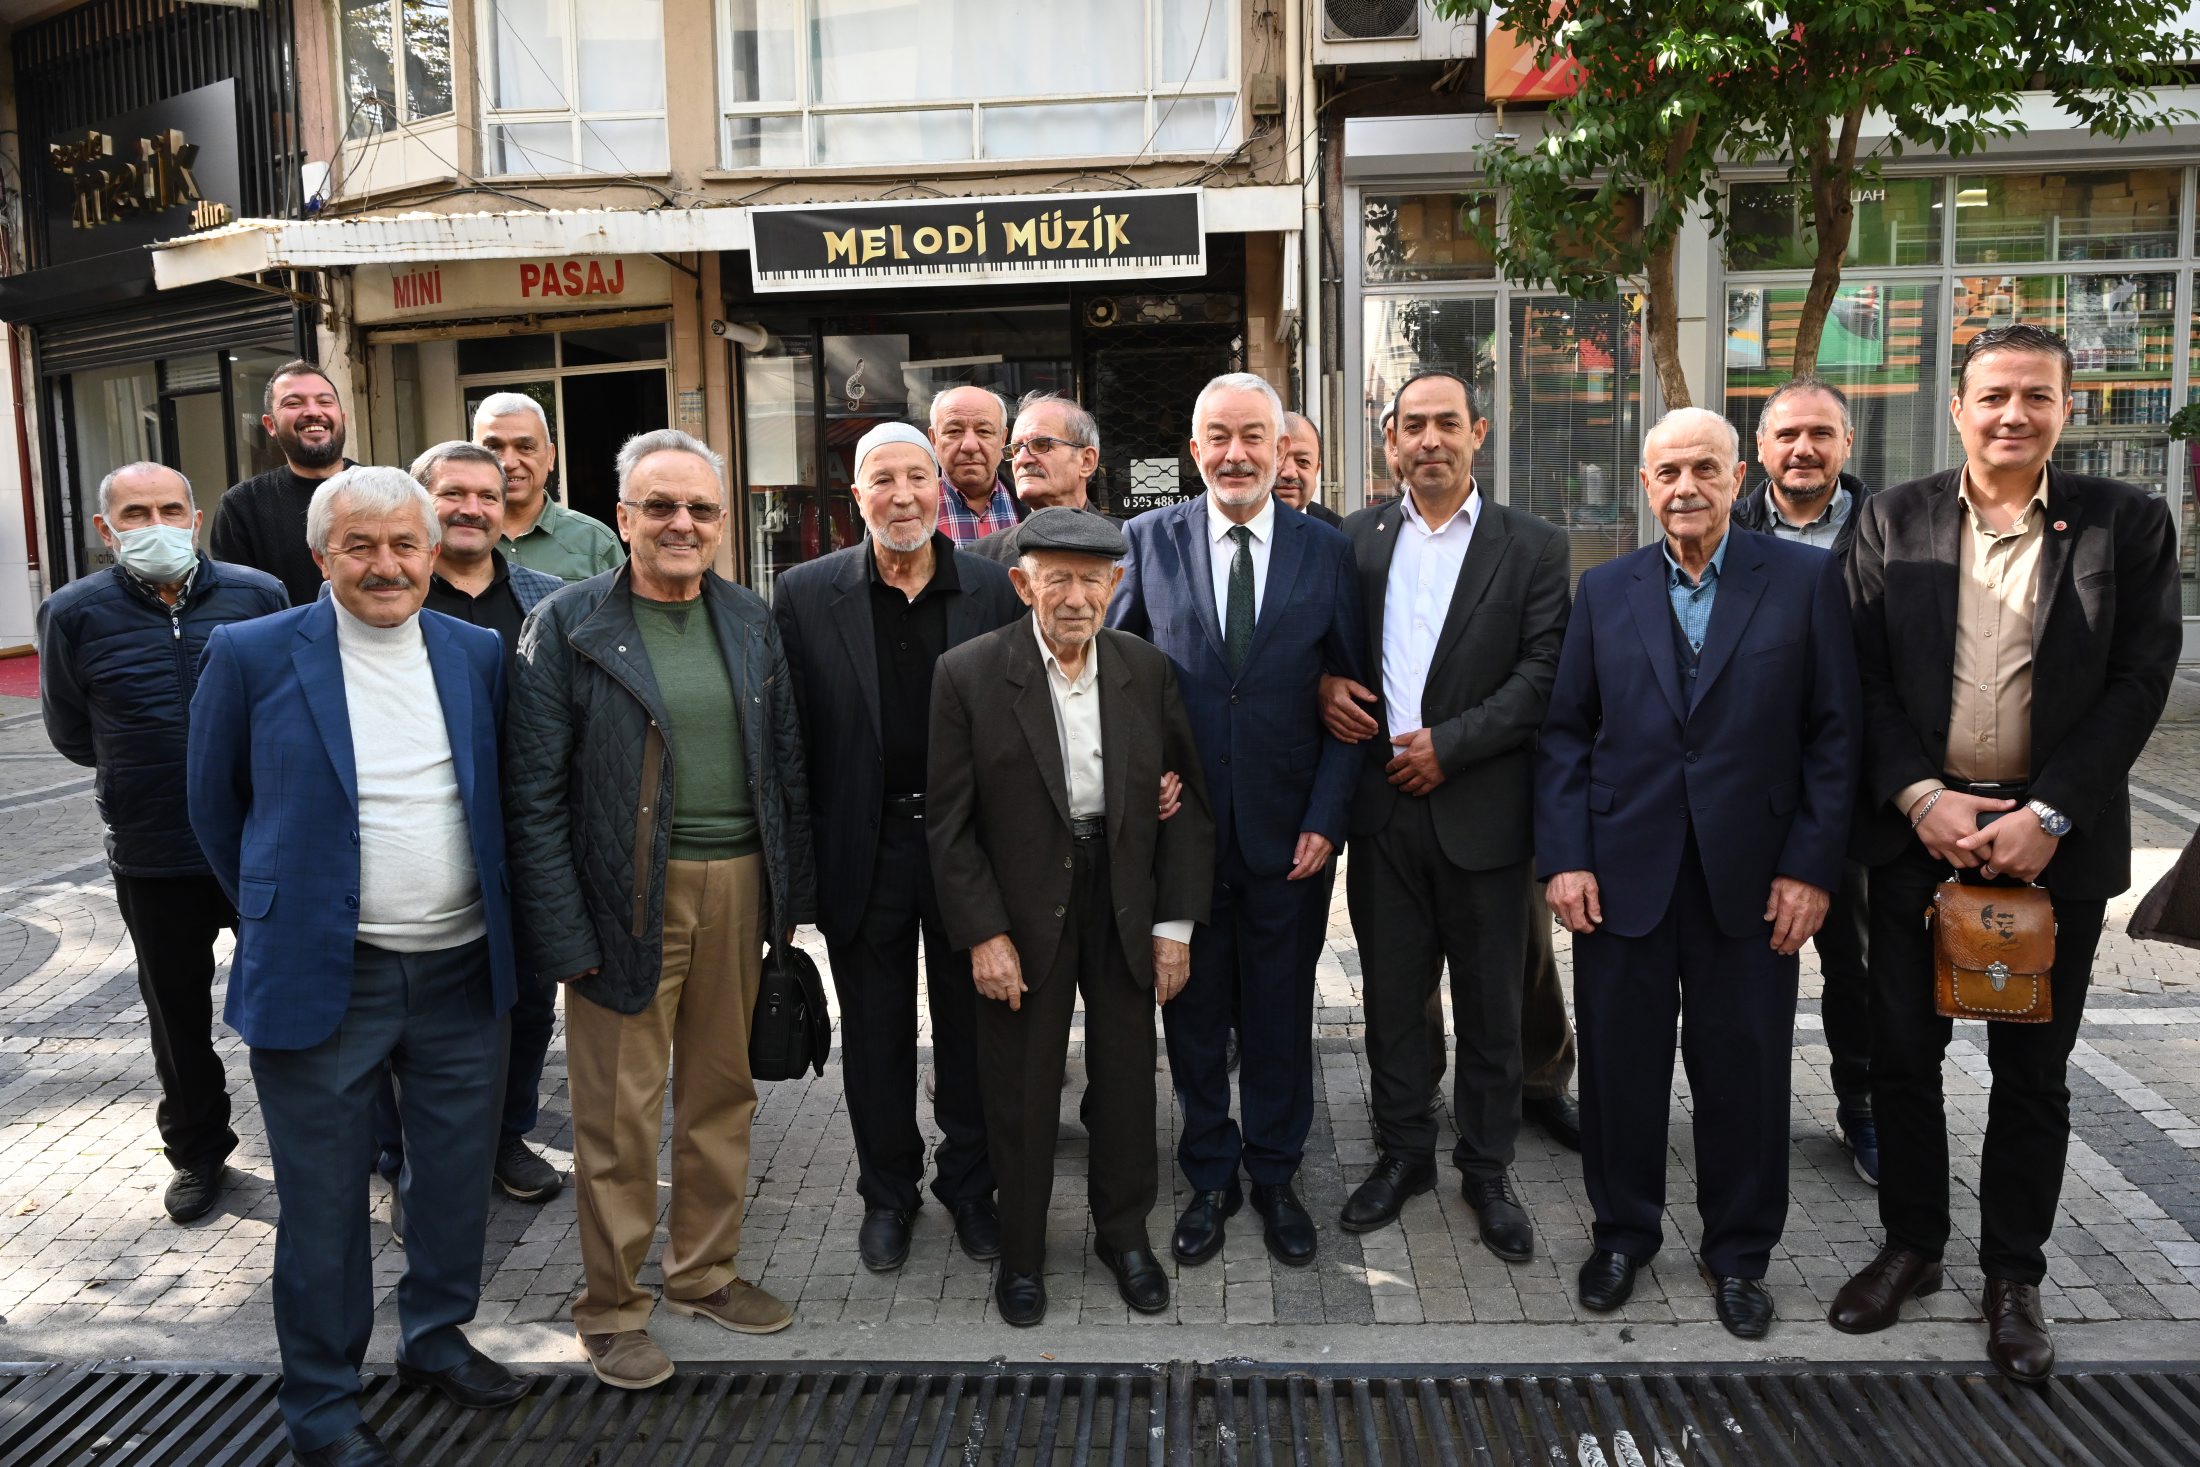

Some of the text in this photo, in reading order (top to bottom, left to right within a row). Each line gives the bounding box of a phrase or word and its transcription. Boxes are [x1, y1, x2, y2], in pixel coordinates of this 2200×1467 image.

[822, 204, 1131, 265] MELODİ MÜZİK
[392, 259, 625, 309] MİNİ PASAJ
